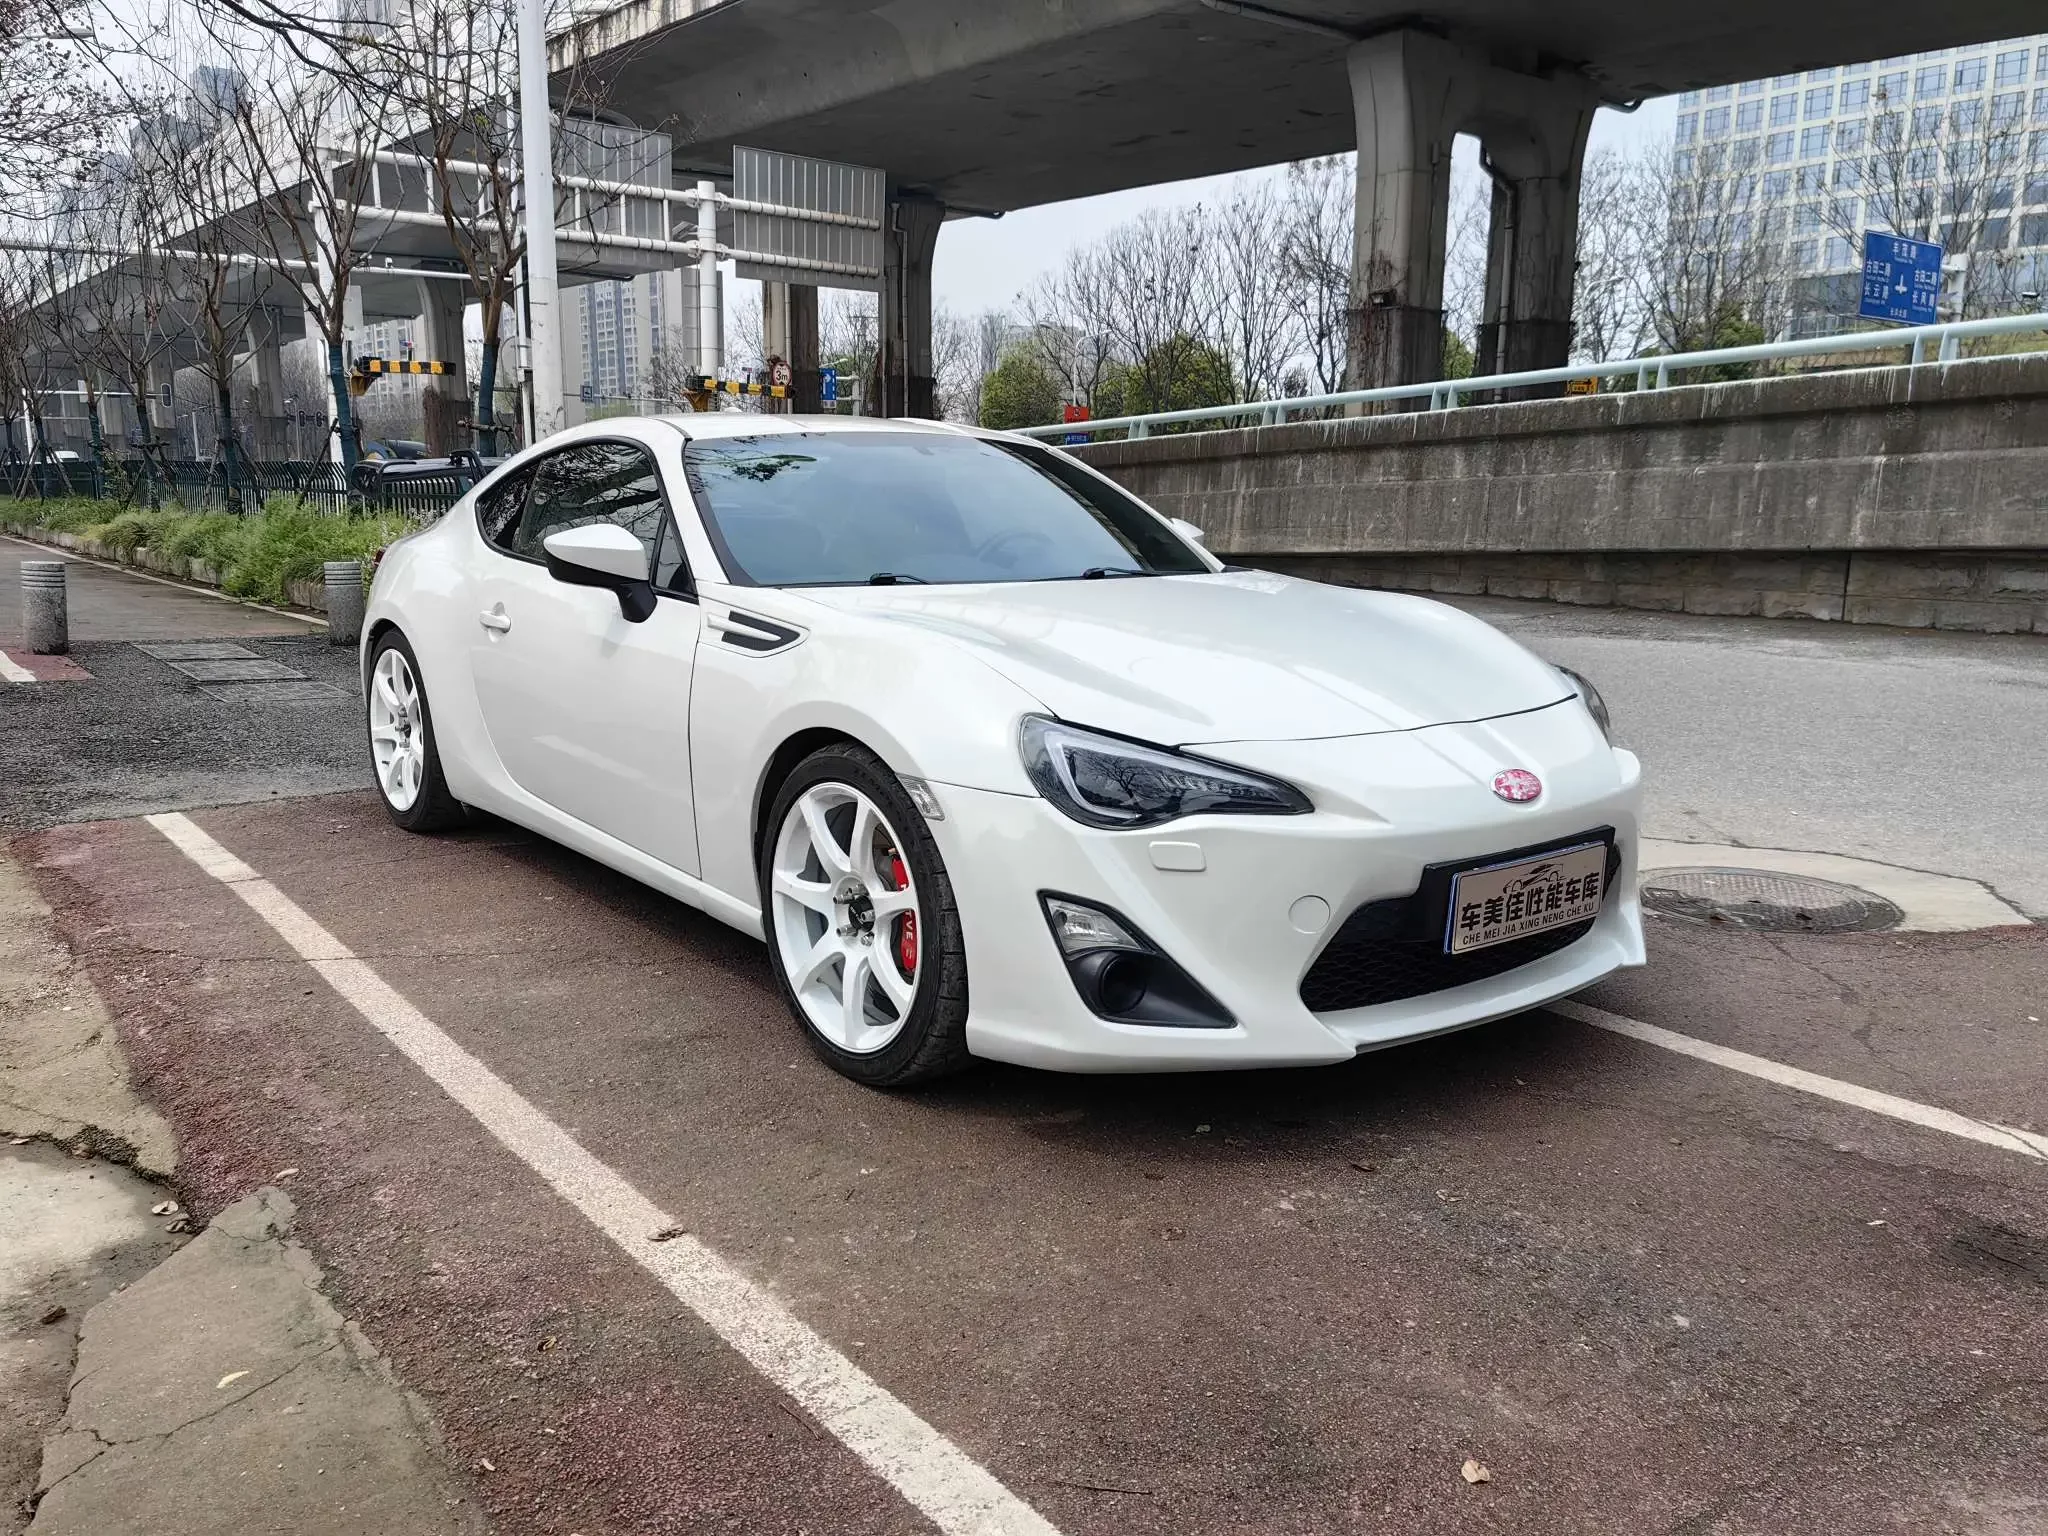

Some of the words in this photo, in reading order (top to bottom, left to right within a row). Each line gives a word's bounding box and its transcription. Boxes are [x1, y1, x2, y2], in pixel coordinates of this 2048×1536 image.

[1866, 260, 1891, 277] 古田二路
[1914, 270, 1937, 286] 古田二路
[1460, 872, 1600, 931] 车美佳性能车库
[1462, 933, 1481, 945] CHE
[1483, 927, 1501, 940] MEI
[1502, 922, 1517, 936] JIA
[1519, 917, 1540, 931] XING
[1542, 910, 1564, 925] NENG
[1566, 905, 1583, 917] CHE
[1584, 902, 1594, 913] KU
